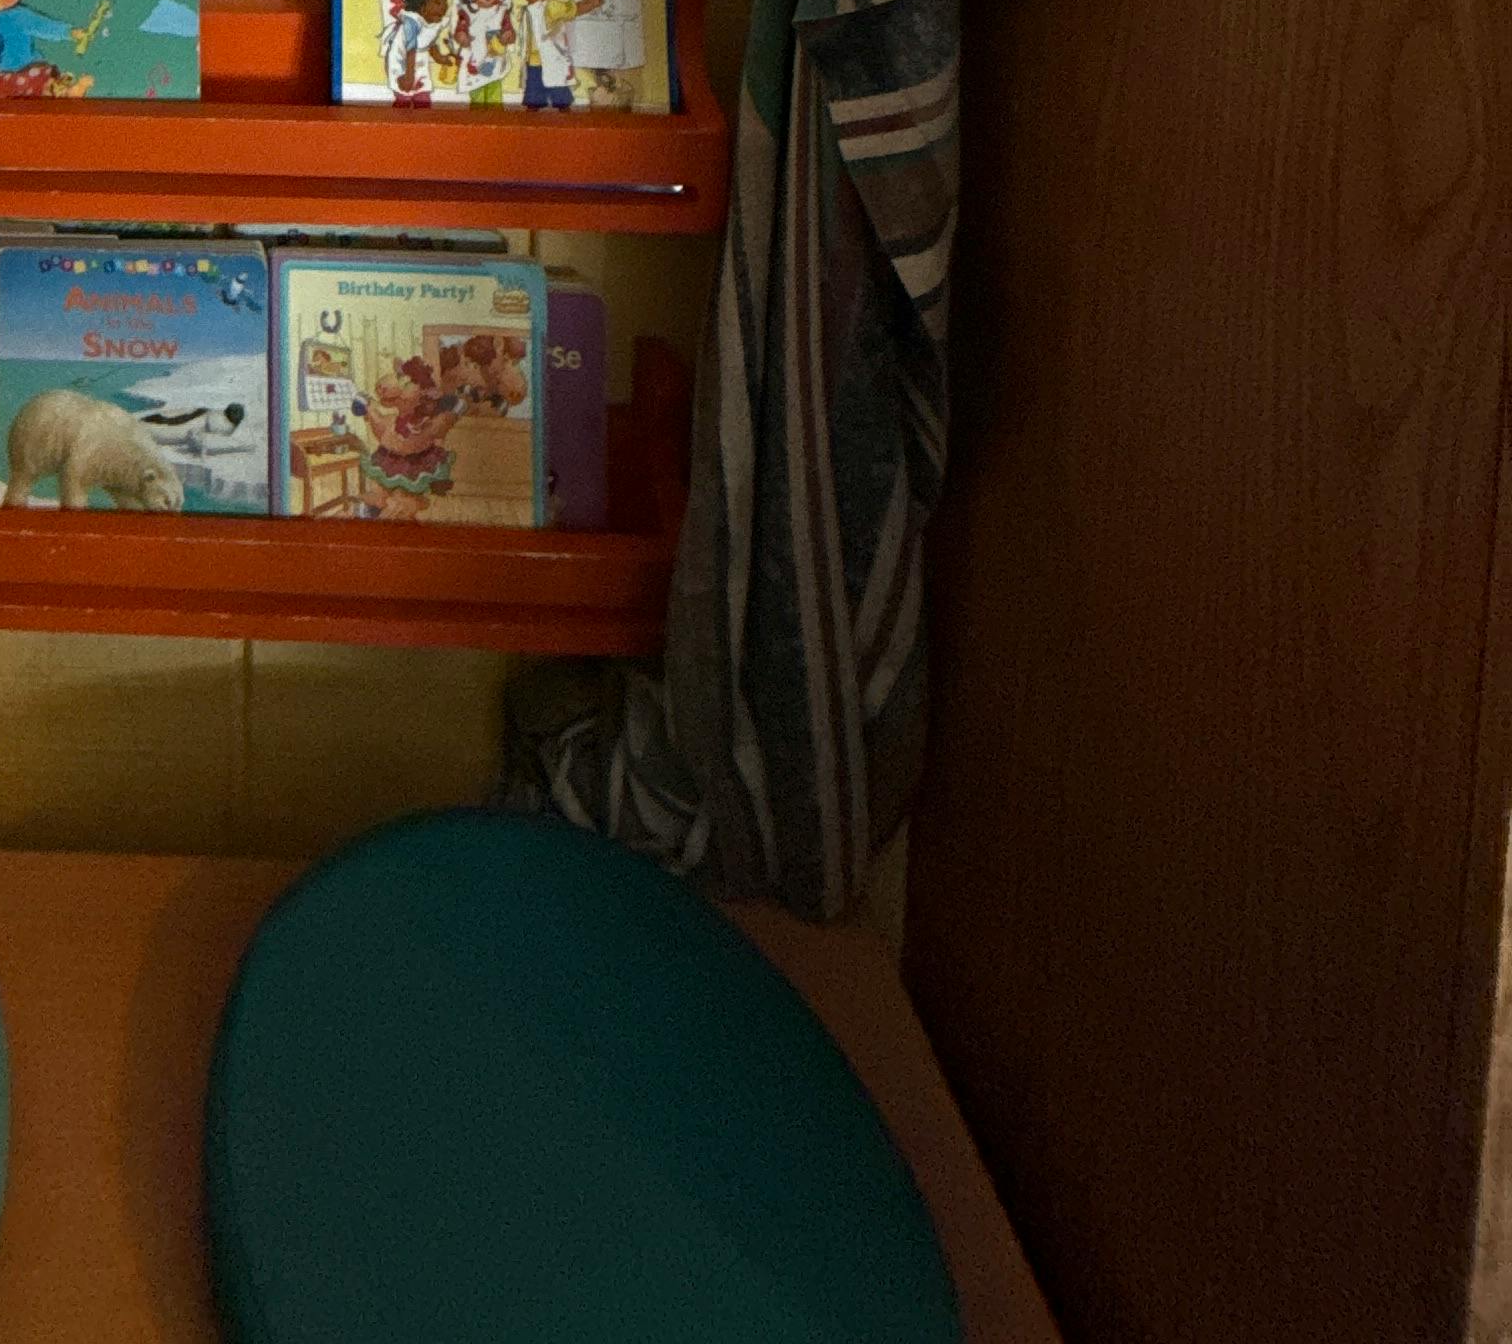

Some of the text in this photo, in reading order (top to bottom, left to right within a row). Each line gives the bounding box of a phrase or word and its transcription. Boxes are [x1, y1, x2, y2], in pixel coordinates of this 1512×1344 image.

[64, 285, 199, 314] ANIMALS
[337, 280, 475, 302] Birthday Party!
[81, 332, 178, 360] SNOW
